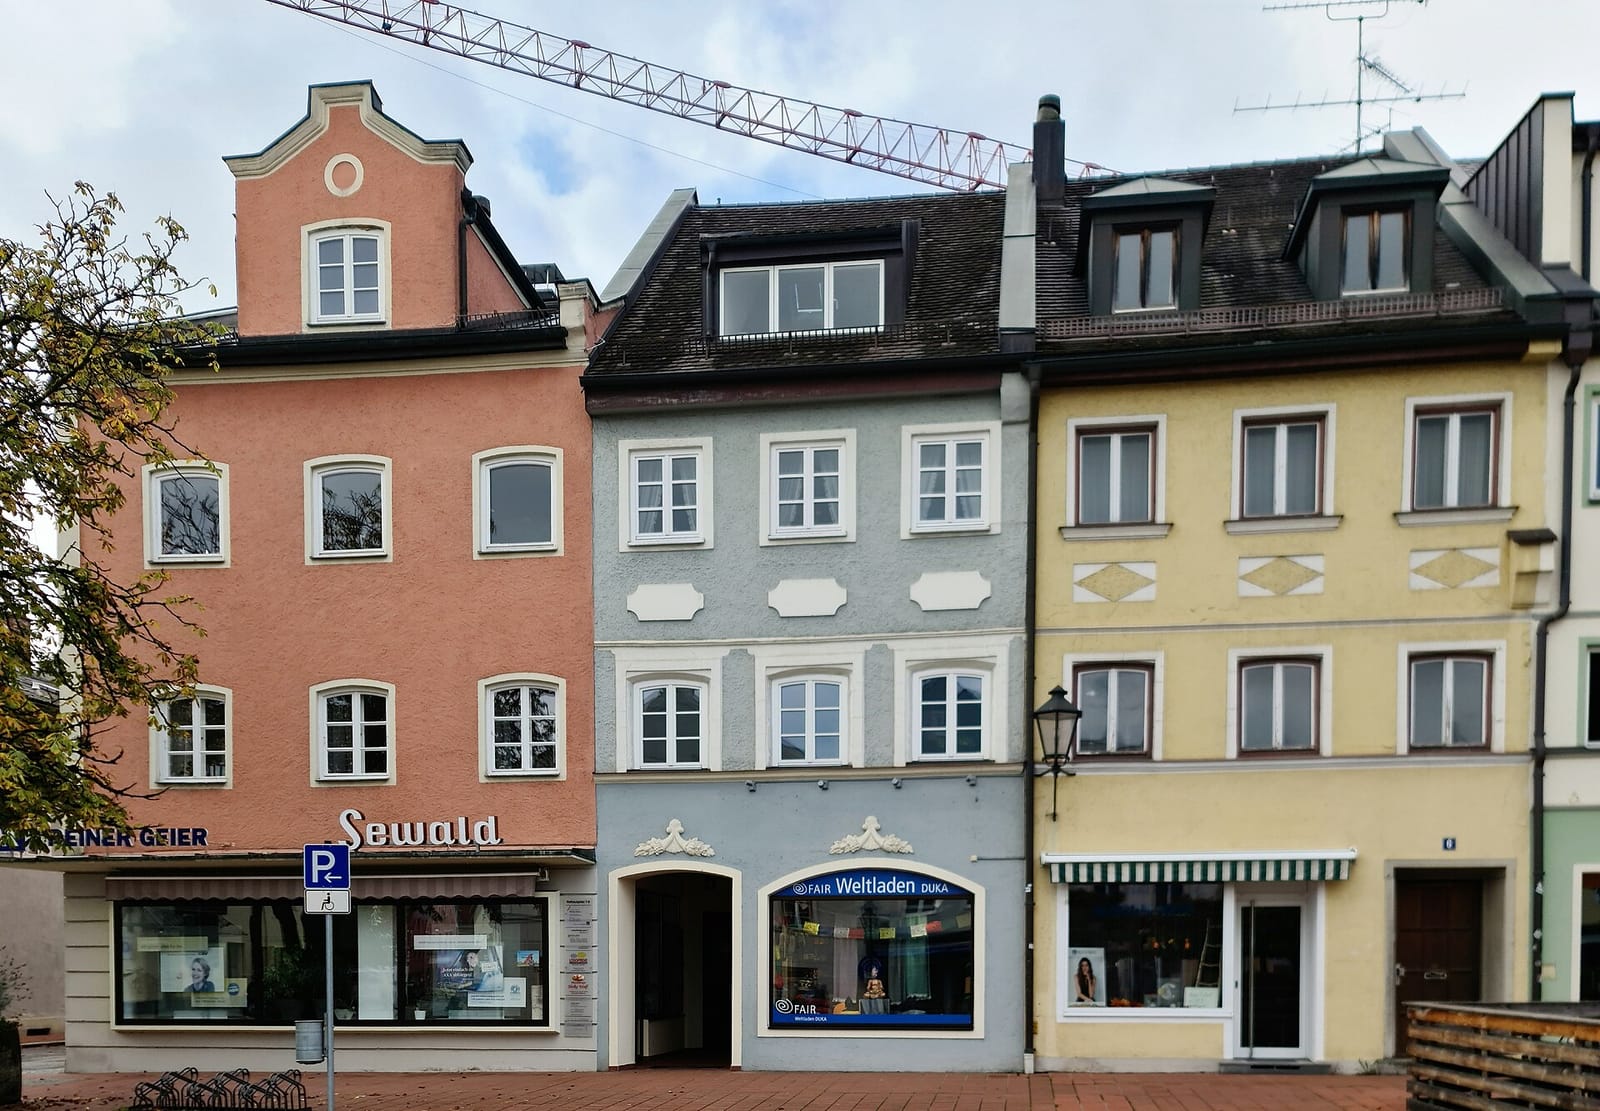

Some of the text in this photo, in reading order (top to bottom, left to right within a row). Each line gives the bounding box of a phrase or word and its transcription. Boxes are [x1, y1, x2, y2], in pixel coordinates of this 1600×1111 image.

[139, 827, 208, 847] GEIER
[338, 808, 502, 851] Sewald
[311, 850, 336, 883] P
[808, 876, 949, 894] FAIR Weltladen DUKA
[794, 1004, 816, 1014] FAIR
